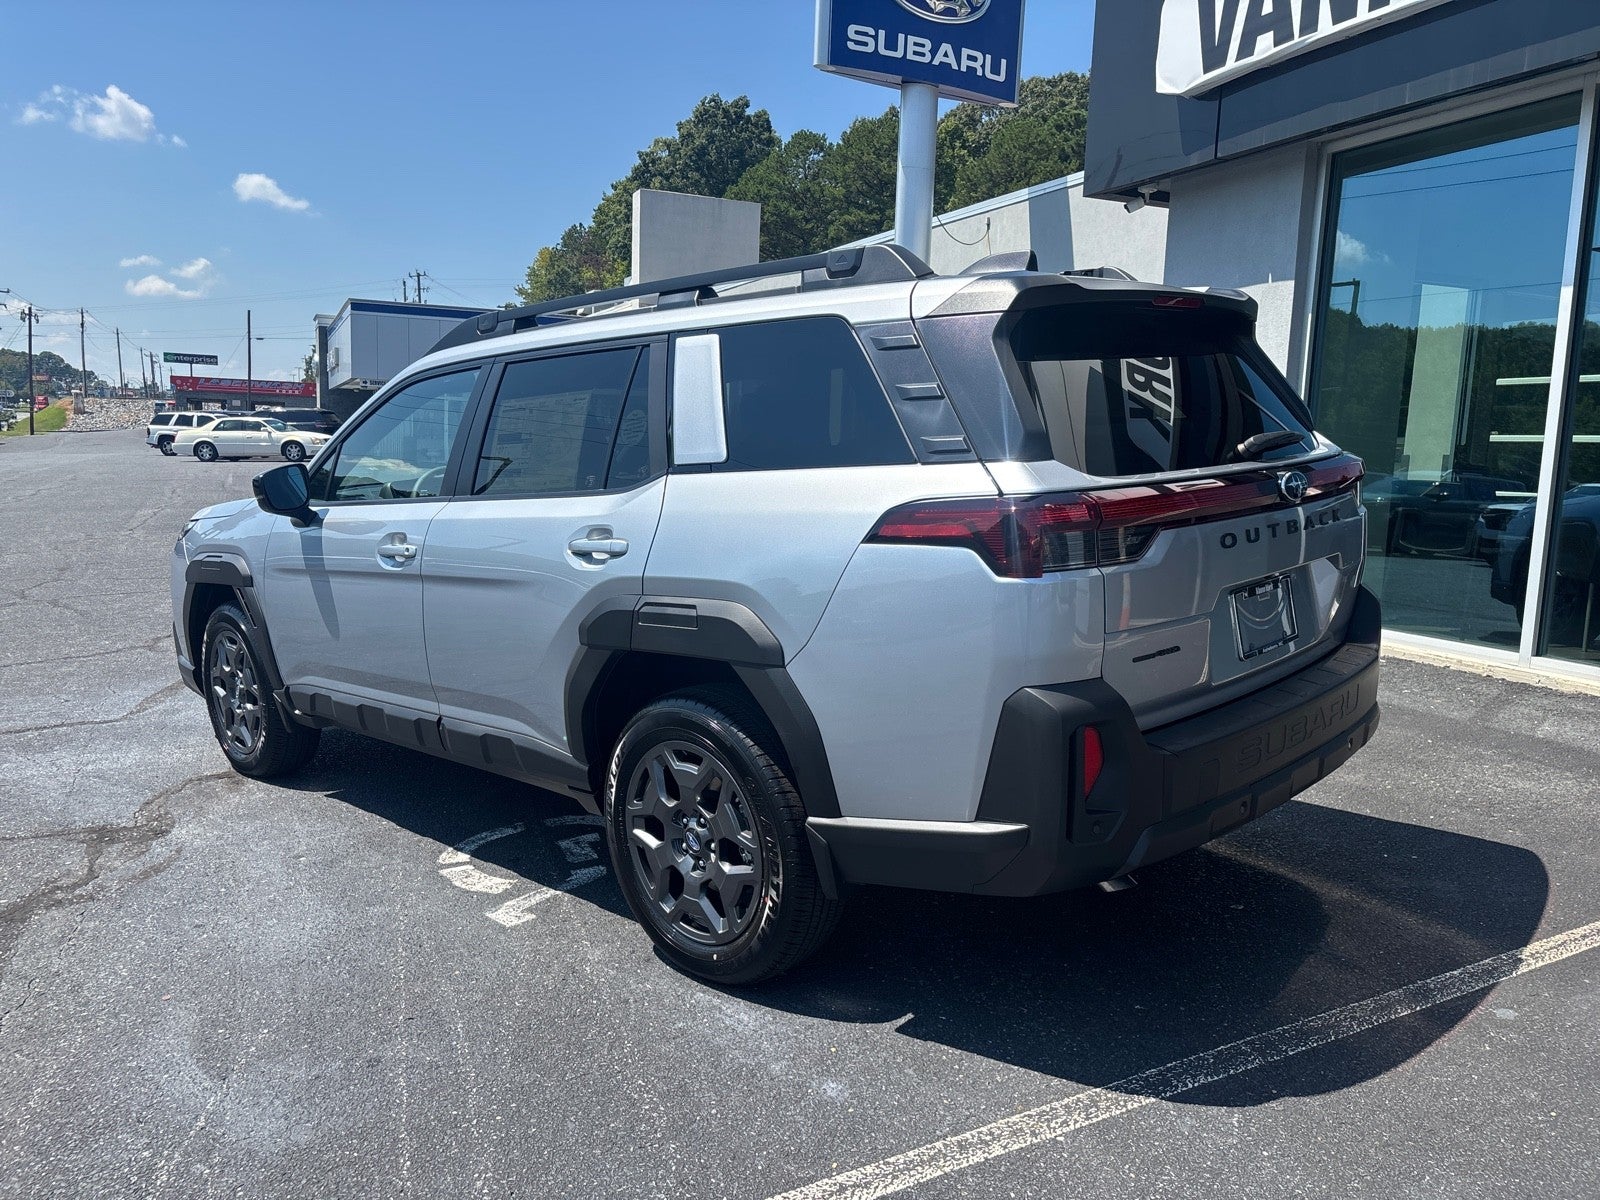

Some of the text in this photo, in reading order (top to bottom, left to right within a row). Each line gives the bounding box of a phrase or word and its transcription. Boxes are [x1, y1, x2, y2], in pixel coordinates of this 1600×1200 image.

[846, 24, 1007, 83] SUBARU
[166, 354, 217, 363] enterprise
[1220, 509, 1341, 549] OUTBACK
[1238, 683, 1360, 773] SUBARU
